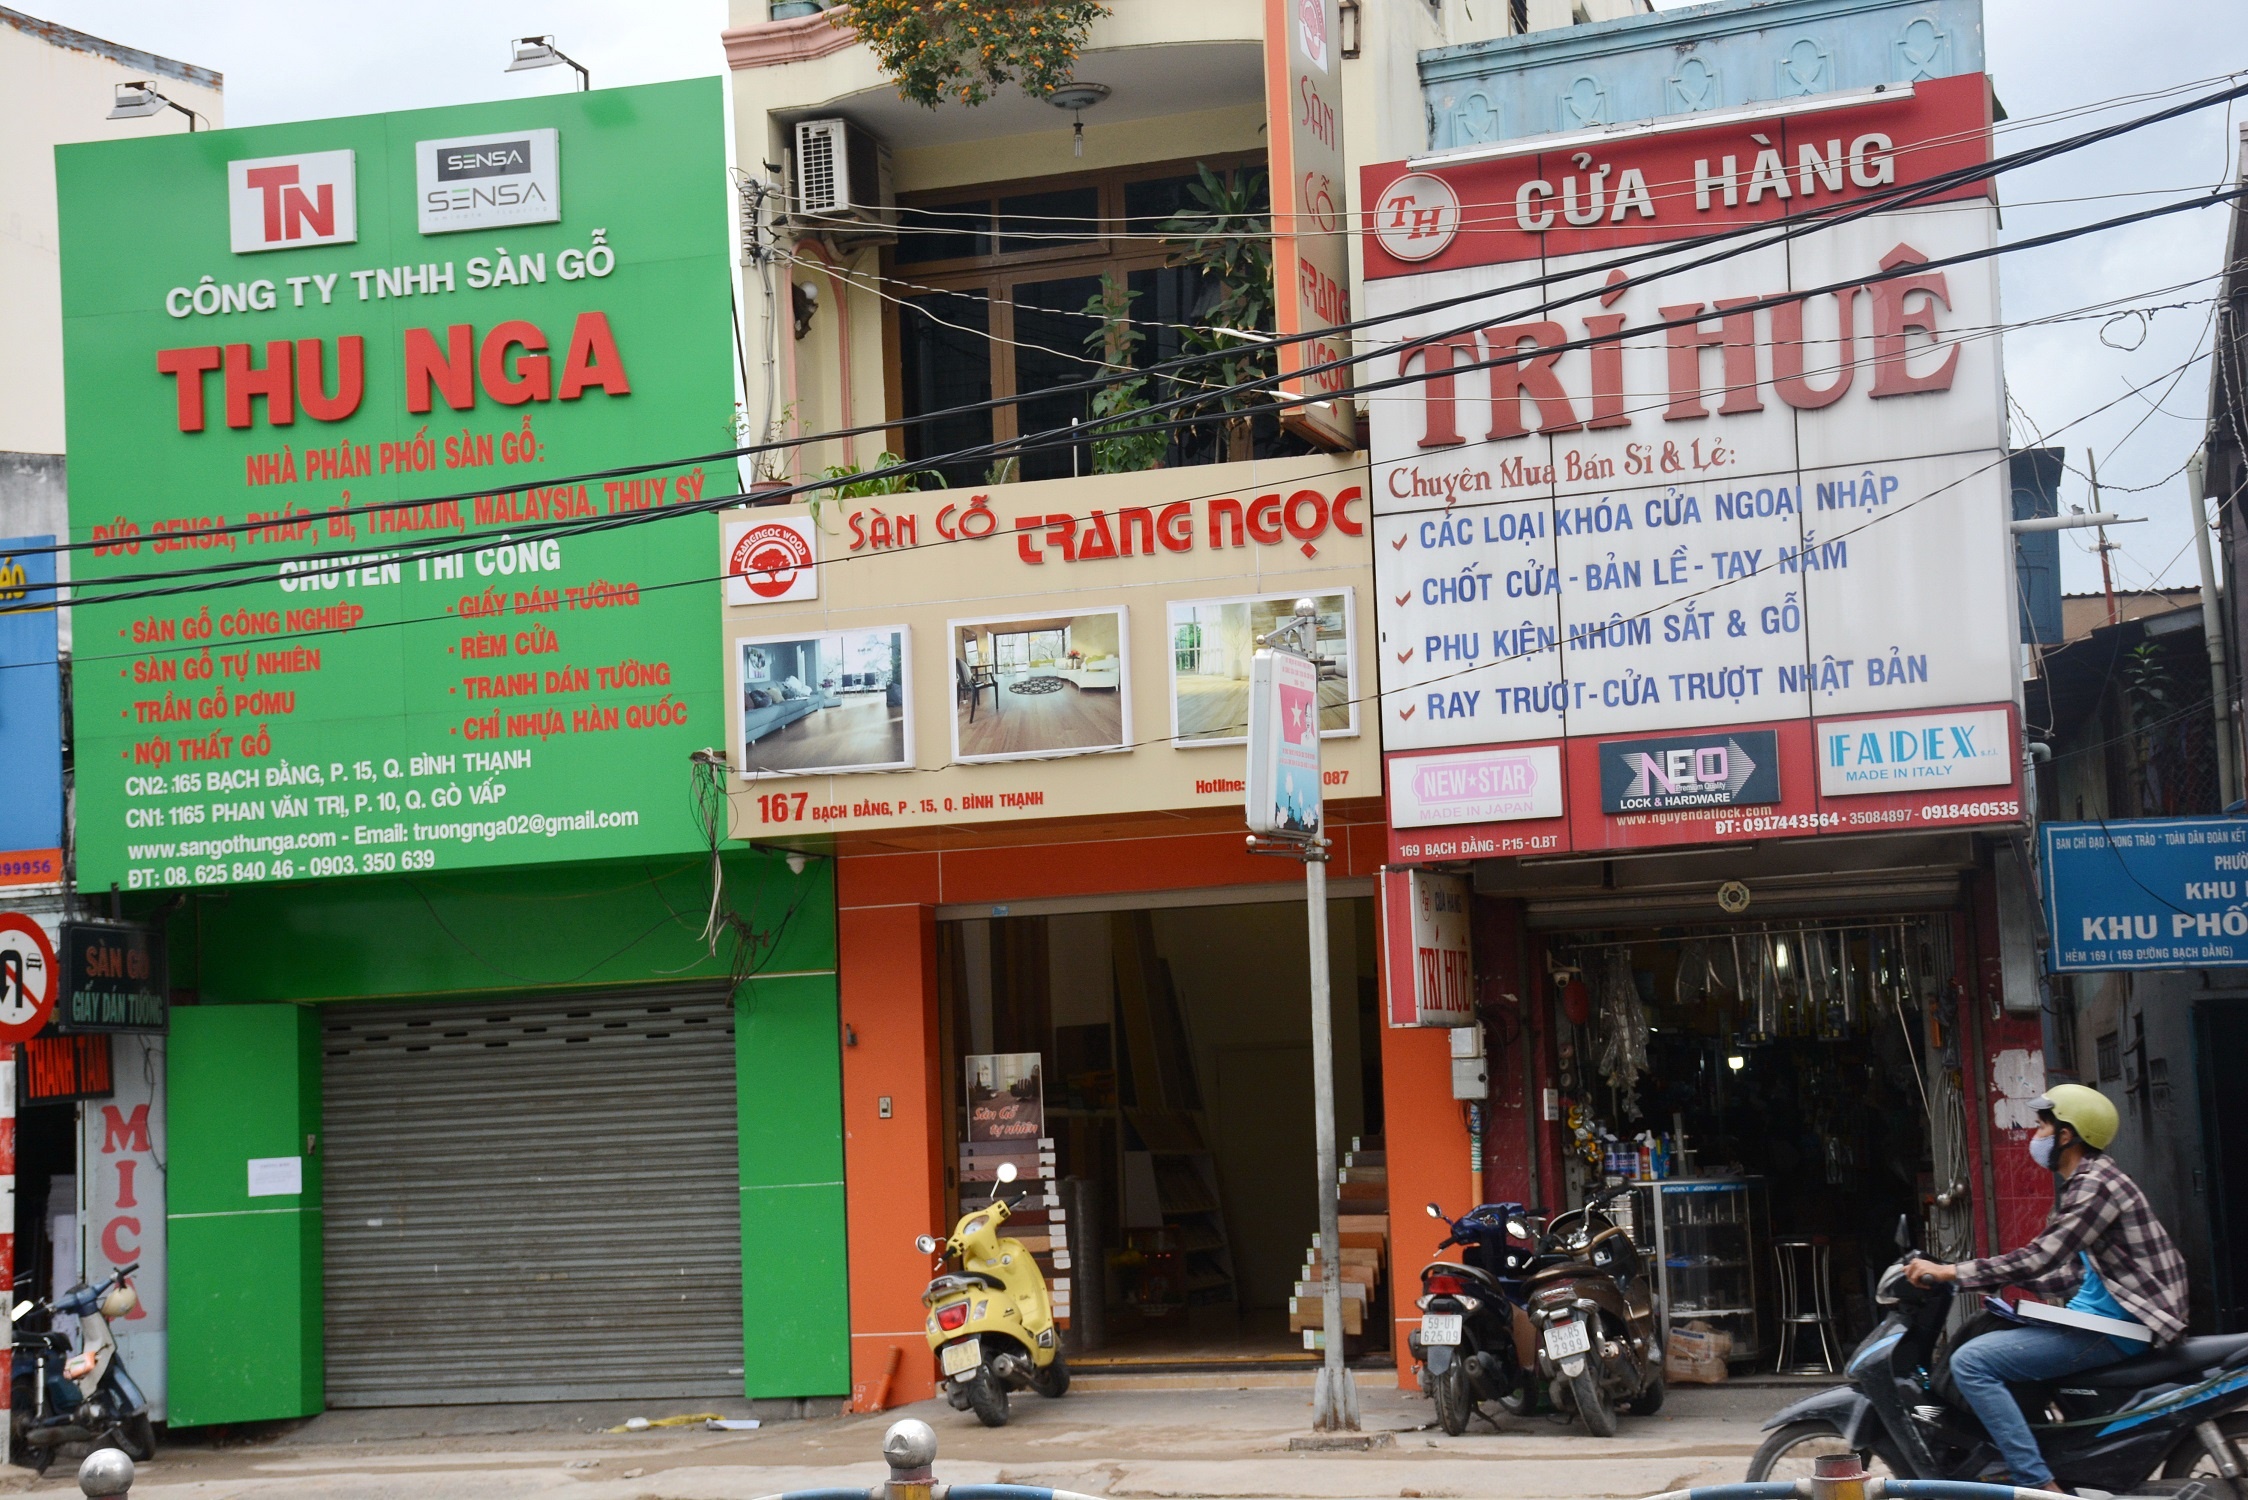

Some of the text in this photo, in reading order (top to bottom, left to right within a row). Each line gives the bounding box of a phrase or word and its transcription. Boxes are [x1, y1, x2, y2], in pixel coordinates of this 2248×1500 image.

[1301, 75, 1335, 151] SÀN
[447, 149, 523, 171] SENSA
[247, 164, 335, 243] TN
[427, 181, 546, 213] SENSA
[1516, 133, 1896, 232] CỬA HÀNG
[166, 228, 616, 317] CÔNG TY TNHH SÀN GỖ
[1398, 241, 1962, 448] TRÍ HUÊ
[157, 311, 632, 433] THU NGA
[246, 414, 545, 487] NHÀ PHÂN PHỐI SÀN GỖ:
[1501, 437, 1736, 491] Mua Bán Lẻ:
[151, 467, 705, 554] SENSA, PHÁP, SỸ
[849, 494, 999, 551] SÀN GỖ
[1015, 486, 1363, 565] TRANG NGỌC
[1420, 470, 1899, 549] CÁC LOẠI KHÓA CỬA NGOẠI NHẬP
[474, 534, 561, 577] CÔNG
[1422, 530, 1848, 606] CHỐT CỬA BẢN LỀ TAY NẮM
[458, 579, 640, 620] GIẤY DÁN TƯỜNG
[131, 600, 365, 644] SÀN GỖ CÔNG NGHIỆP
[460, 623, 560, 660] RÈM CỬA
[1426, 591, 1801, 667] PHỤ KIỆN NHÔM SẮT GỖ
[133, 645, 321, 684] SÀN GỖ TỰ NHIÊN
[463, 658, 671, 700] TRANH DÁN TƯỜNG
[1427, 646, 1928, 720] RAY TRƯỢT NHẬT BẢN
[133, 685, 296, 724] TRẦN GỖ PƠMU
[463, 693, 688, 742] CHỈ NHỰA HÀN QUỐC
[134, 723, 272, 769] NỘI THẤT GỖ
[1829, 725, 1978, 767] FADEX
[206, 749, 532, 794] BẠCH ĐẰNG, BÌNH THẠNH
[1195, 778, 1246, 794] Hotline:
[1641, 747, 1729, 796] NEO
[1846, 765, 1953, 782] MADE IN ITALY
[168, 777, 507, 826] 1165 PHAN VĂN GÒ VẤP
[757, 791, 1044, 824] 167 BẠCH ĐẰNG, BÌNH THẠNH
[1420, 801, 1534, 821] MADE IN JAPAN
[1616, 805, 1773, 827] www.nguyendatlock.com
[1620, 792, 1731, 810] LOCK HARDWARE
[1850, 801, 2019, 825] 35084897 0918460535
[128, 810, 639, 861] www.sangothunga.com Email: truongnga02@gmail.com
[1400, 842, 1457, 858] 169 BẠCH
[2056, 837, 2072, 850] BAN
[2188, 830, 2205, 844] DÂN
[195, 849, 435, 884] 625 840 46 0903. 350 639
[2185, 881, 2237, 900] KHU
[2082, 901, 2248, 941] KHU PHỐ
[85, 938, 123, 979] SÀN
[1419, 924, 1471, 1013] TRÍ HUÊ
[2090, 948, 2107, 961] 169
[102, 985, 126, 1023] DÁN
